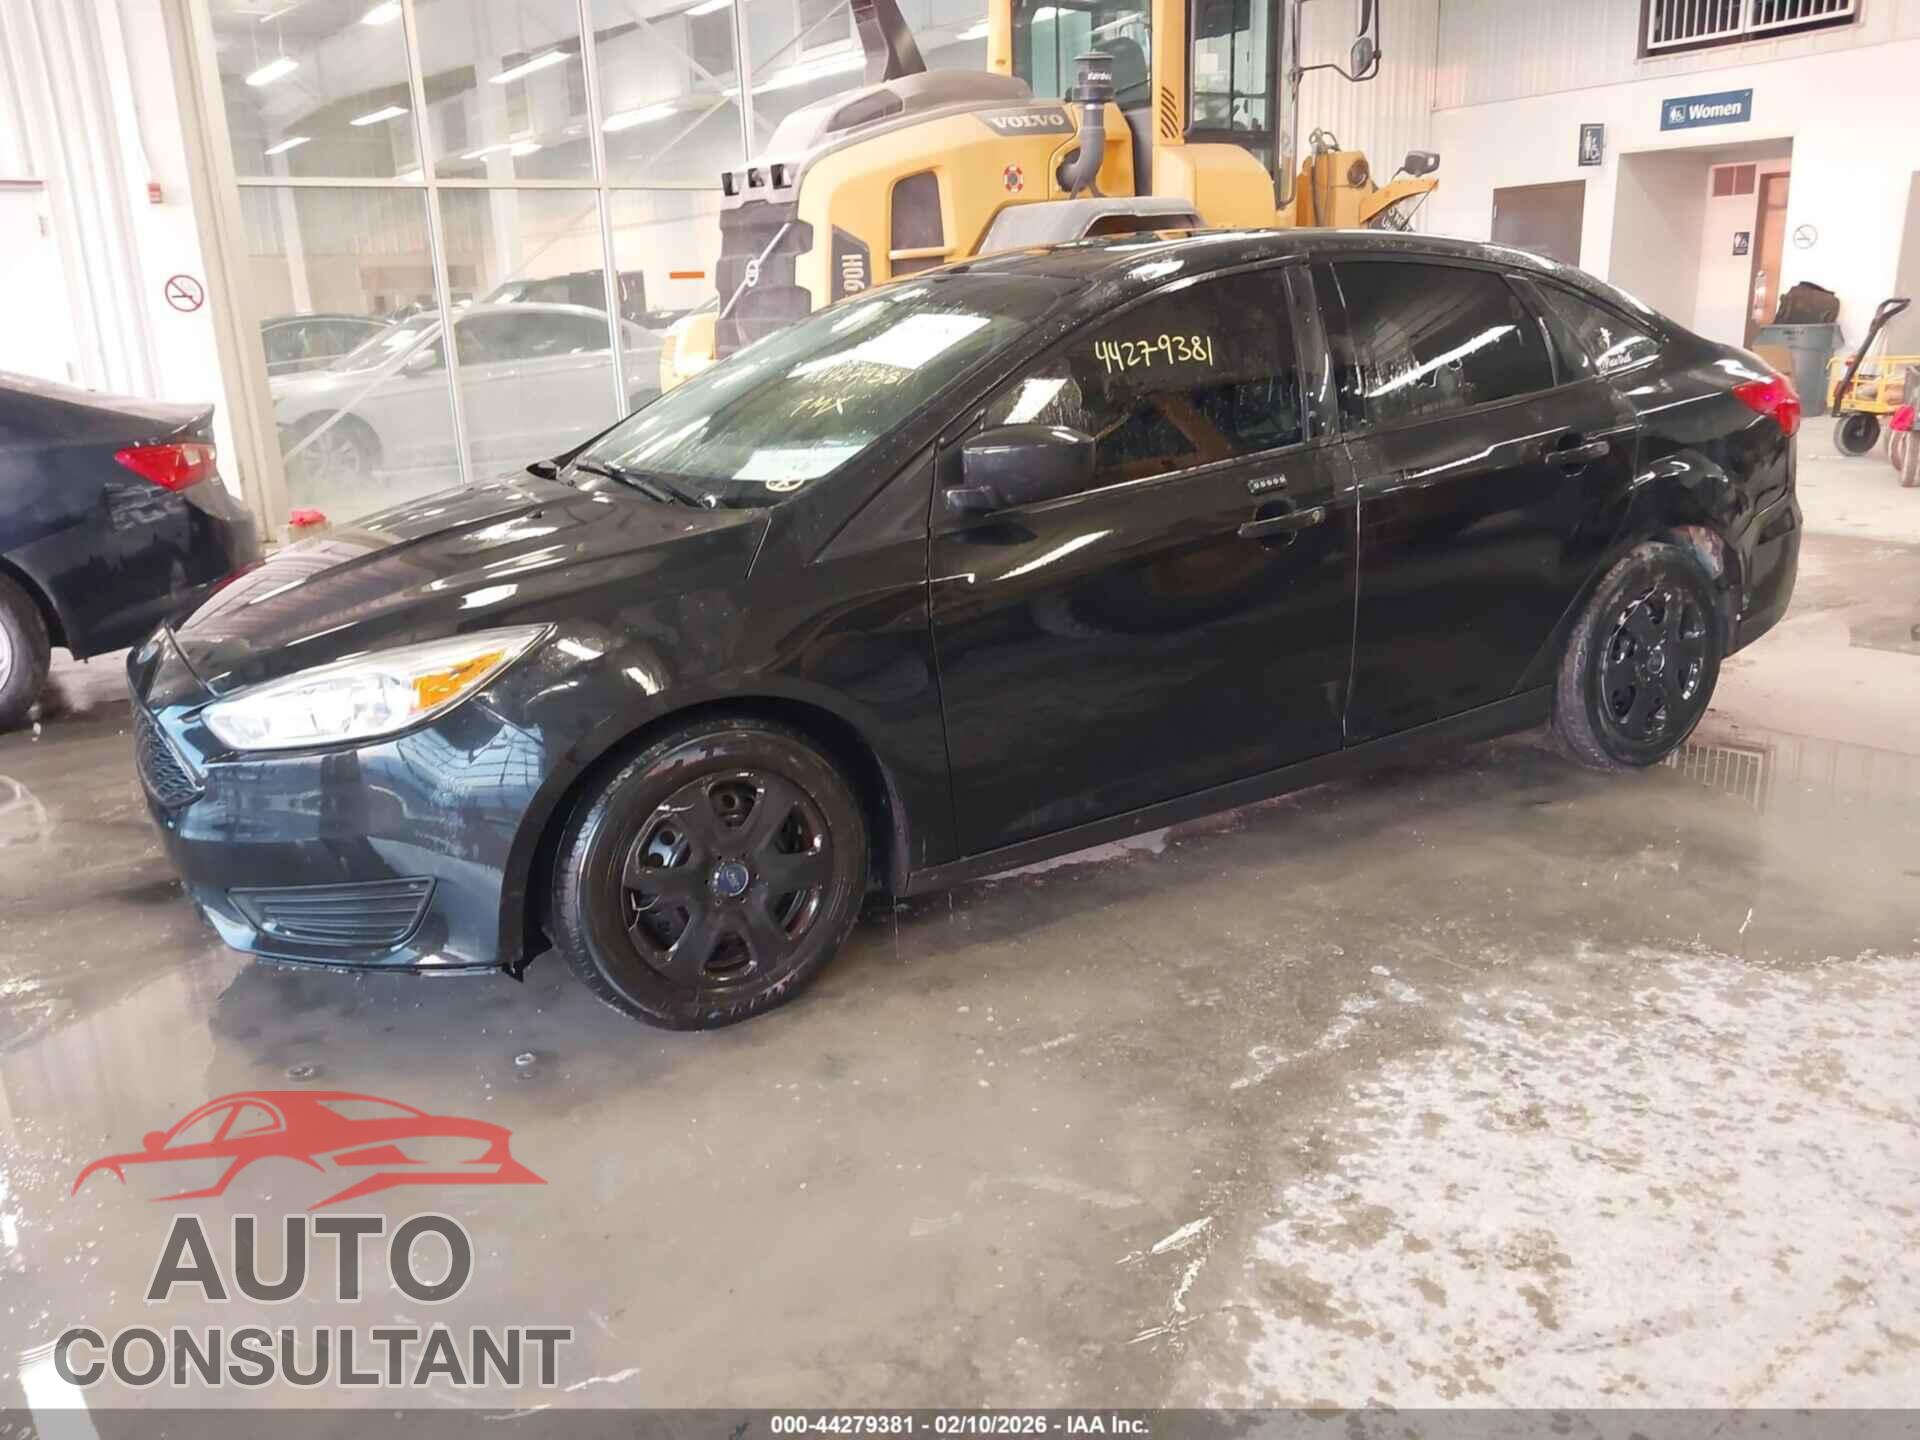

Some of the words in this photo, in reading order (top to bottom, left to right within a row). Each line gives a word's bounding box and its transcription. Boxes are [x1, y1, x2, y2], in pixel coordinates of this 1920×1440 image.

[990, 114, 1065, 129] VOLVO
[1689, 102, 1742, 120] Women
[841, 254, 865, 296] 90H
[1095, 334, 1213, 374] 44279381
